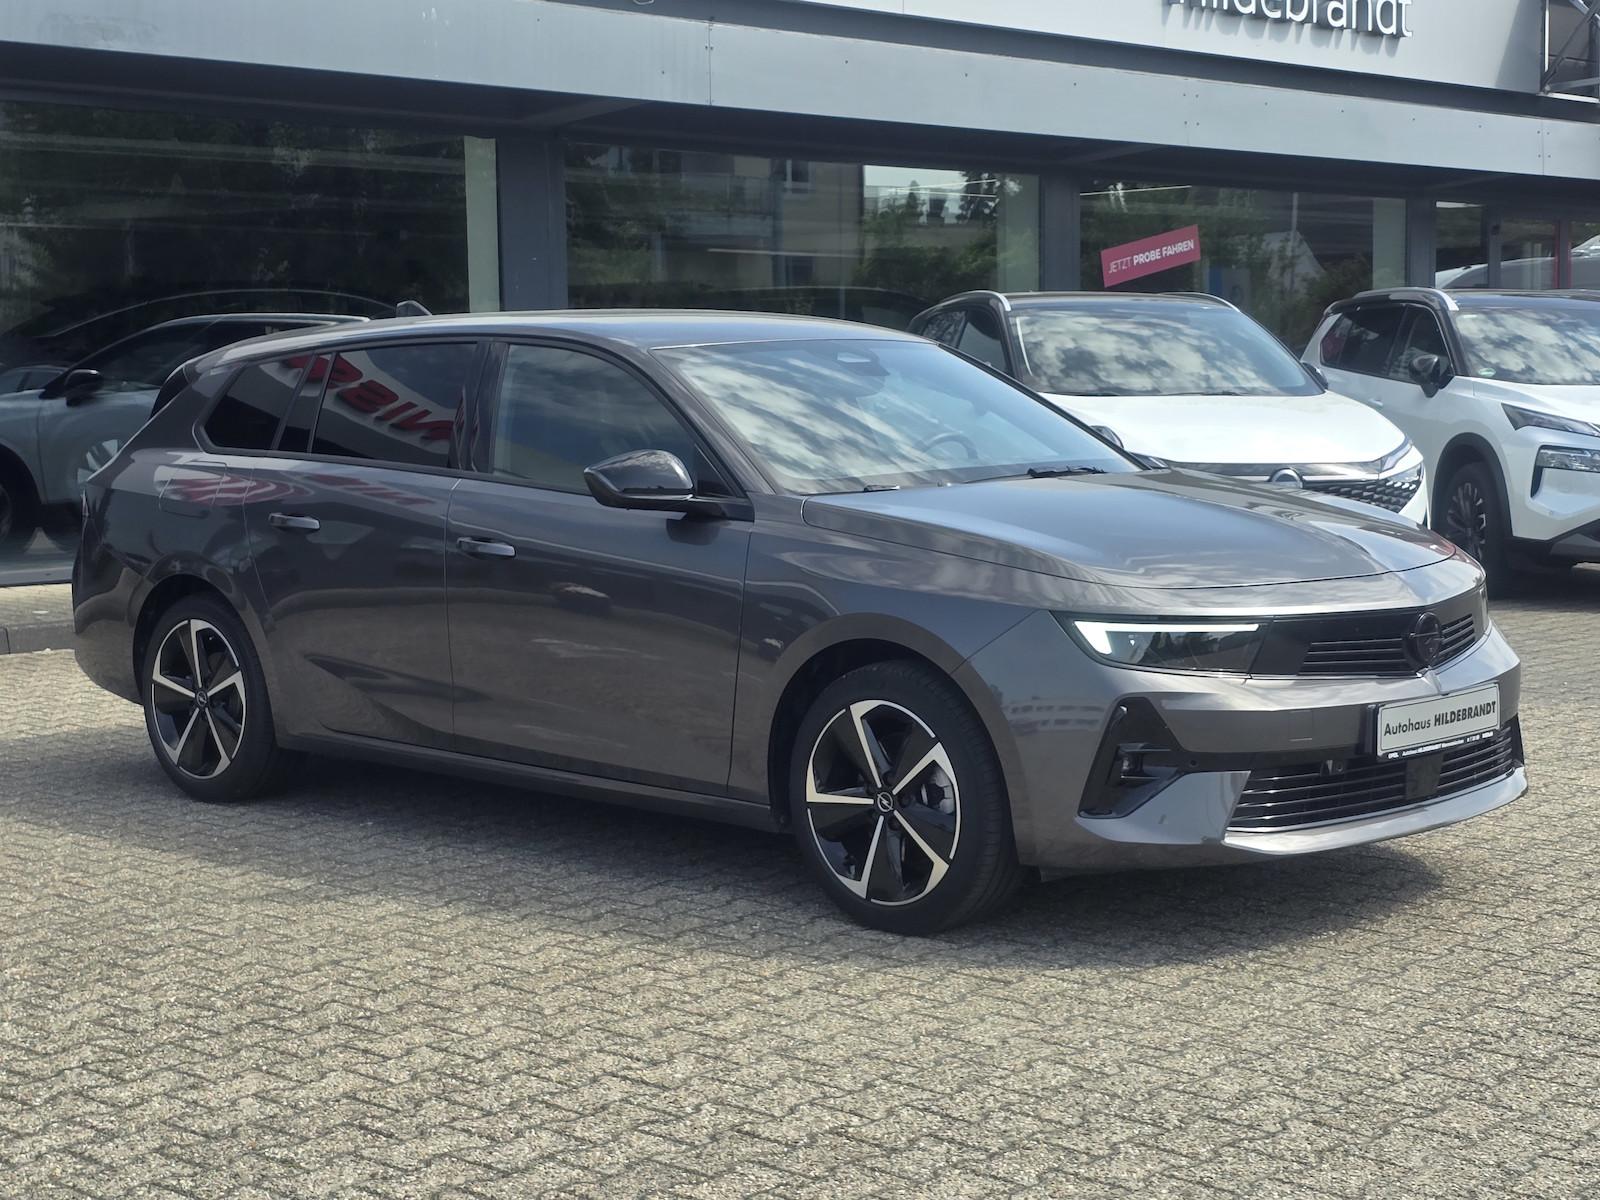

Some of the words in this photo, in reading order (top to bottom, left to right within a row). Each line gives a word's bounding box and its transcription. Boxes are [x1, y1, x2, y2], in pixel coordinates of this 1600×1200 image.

[1108, 257, 1132, 274] JETZT
[1133, 248, 1161, 266] PROBE
[1162, 239, 1194, 257] FAHREN
[1384, 718, 1431, 736] Autohaus
[1434, 701, 1496, 727] HILDEBRANDT
